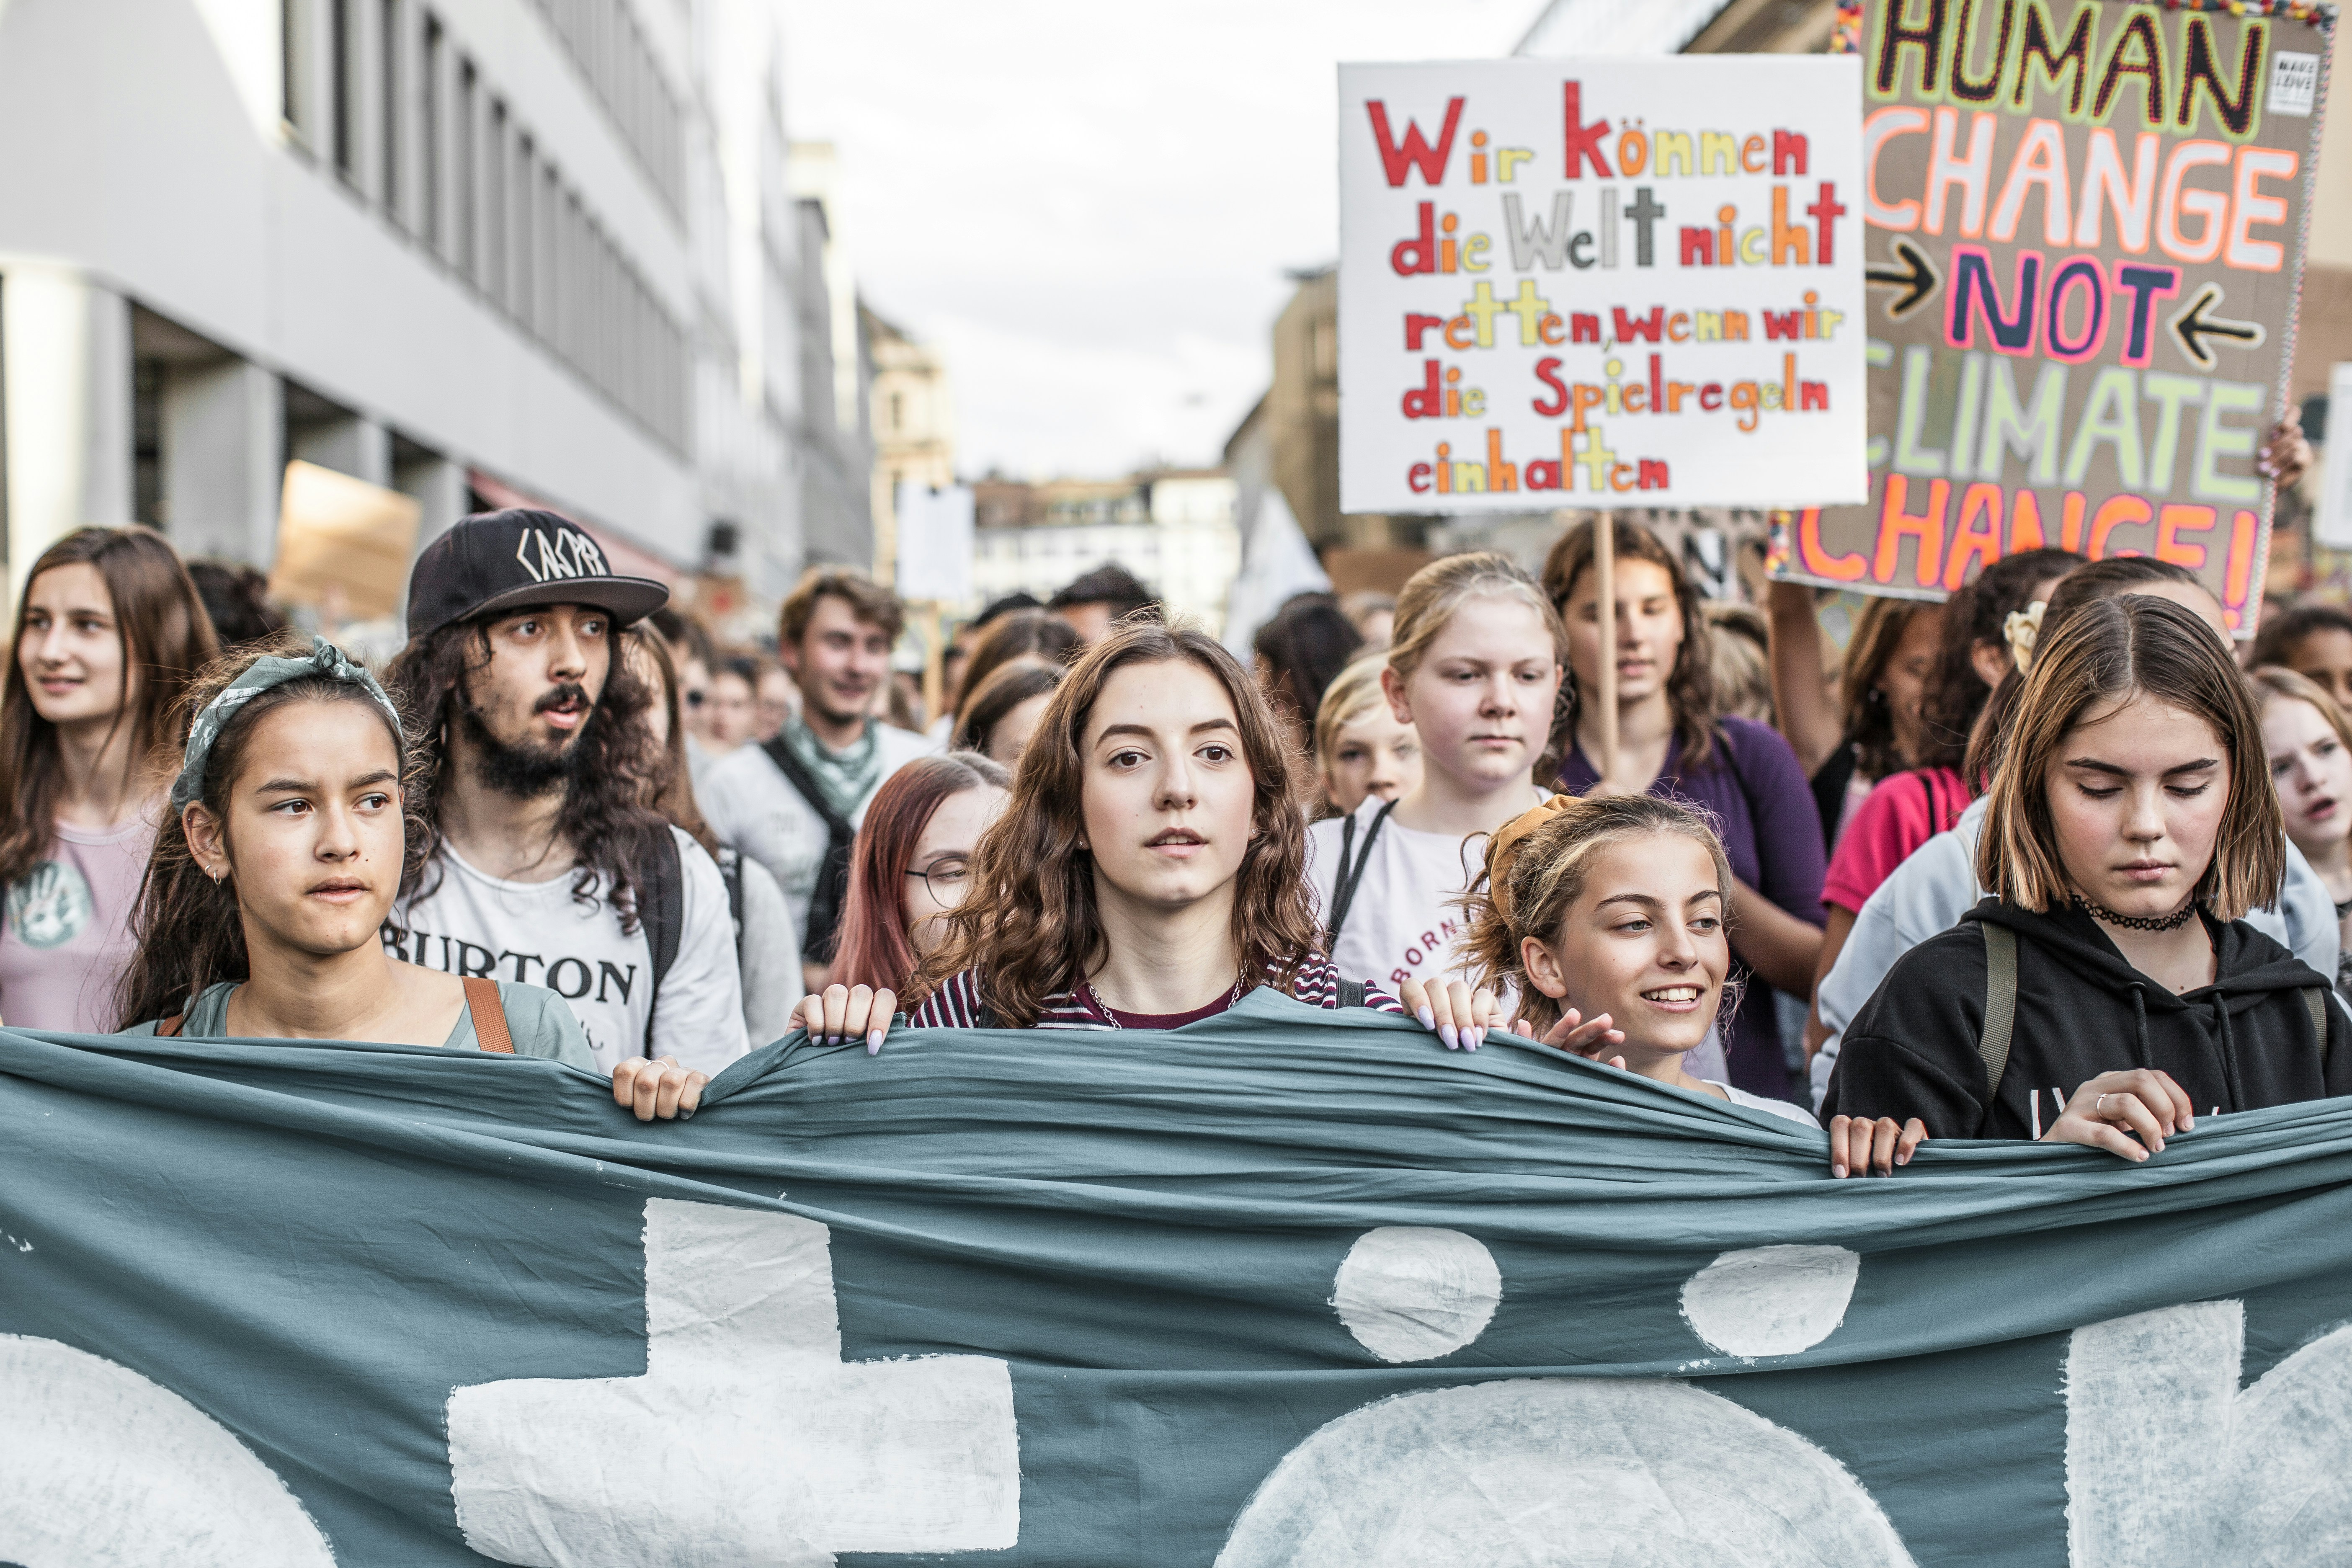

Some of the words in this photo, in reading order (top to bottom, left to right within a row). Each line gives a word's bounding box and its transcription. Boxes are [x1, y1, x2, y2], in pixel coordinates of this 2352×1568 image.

[1873, 0, 2269, 140] HUMAN
[1365, 96, 1534, 188] Wir
[1564, 80, 1809, 179] können
[1391, 200, 1491, 276] die
[1502, 187, 1666, 271] Welt
[1679, 182, 1847, 266] nicht
[1864, 106, 2299, 274] CHANGE
[1762, 291, 1844, 340] wir
[1945, 244, 2183, 369] NOT
[1402, 358, 1486, 419] die
[1533, 353, 1830, 433] Spielregeln
[1408, 426, 1670, 493] einhalten
[379, 926, 637, 1005] BURTON
